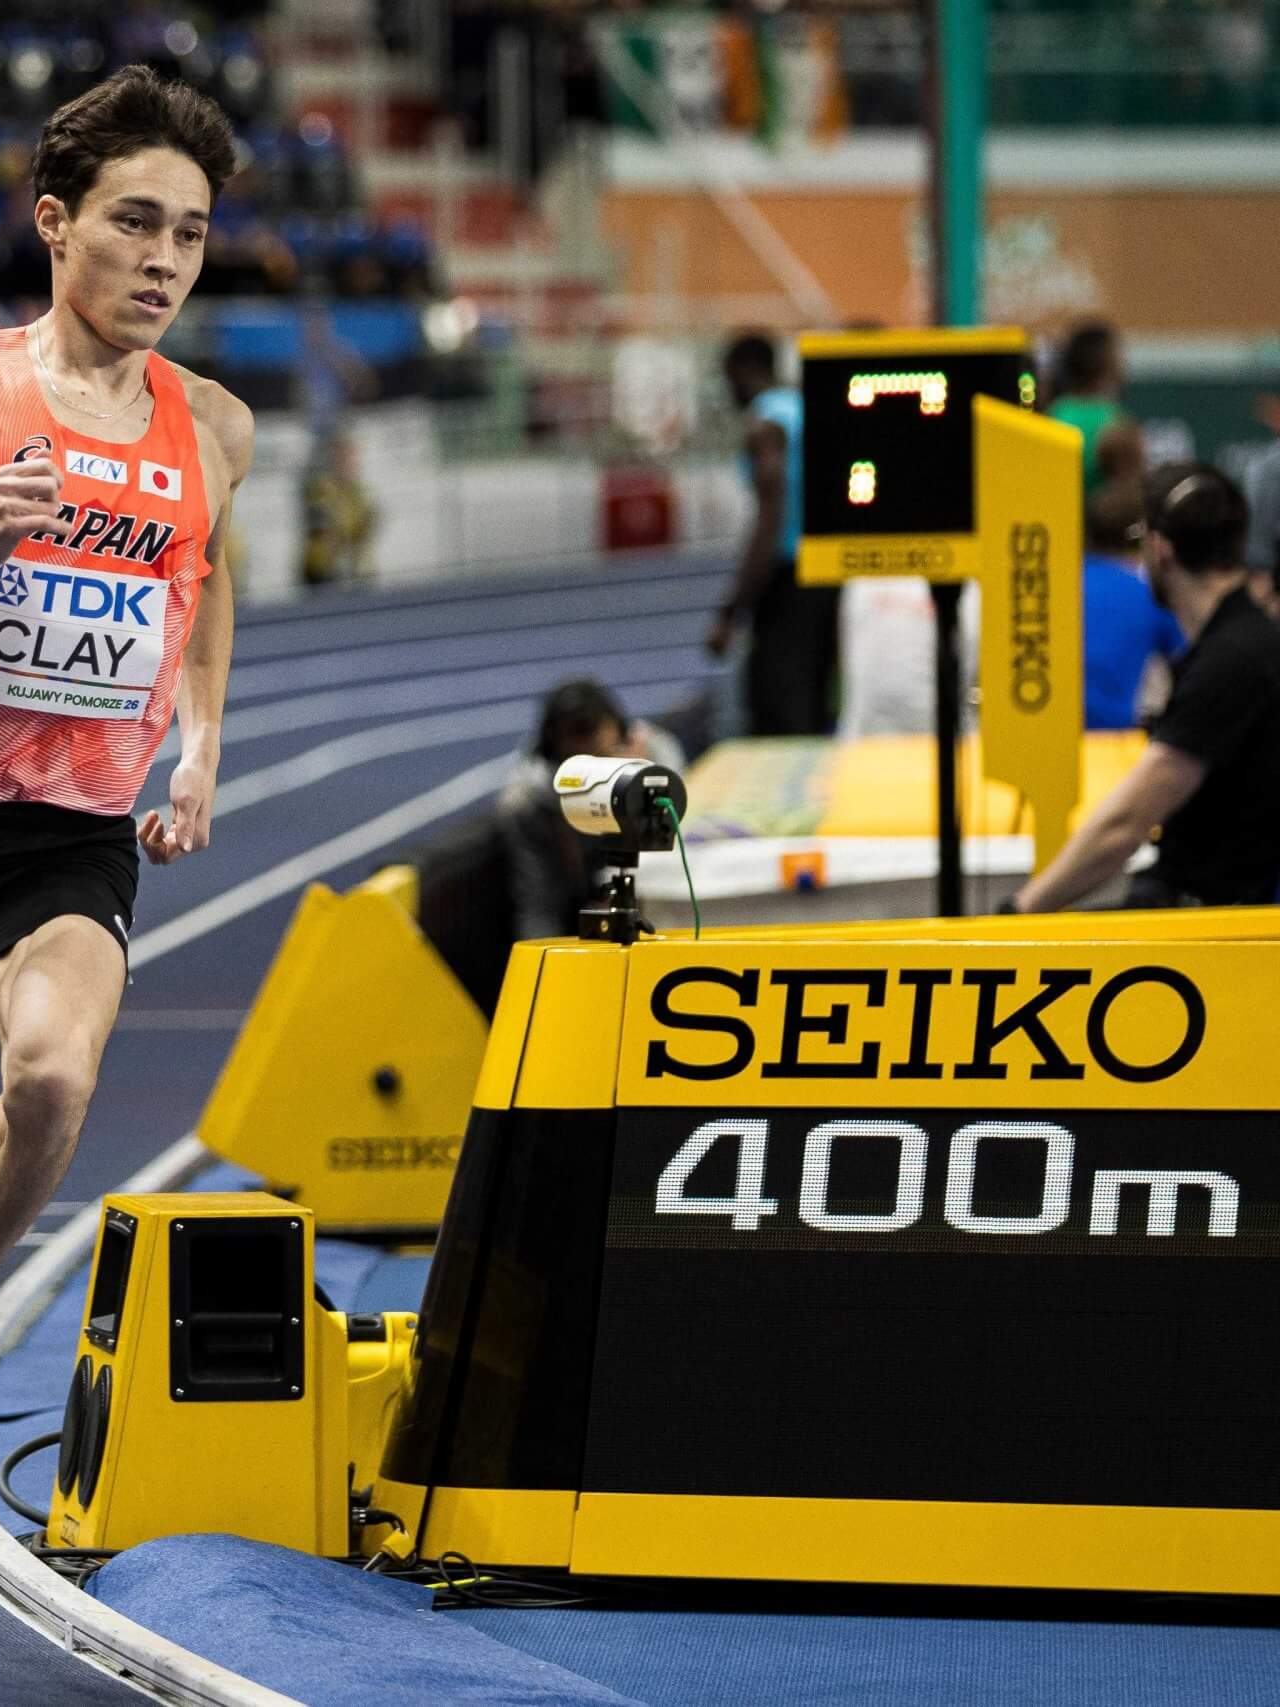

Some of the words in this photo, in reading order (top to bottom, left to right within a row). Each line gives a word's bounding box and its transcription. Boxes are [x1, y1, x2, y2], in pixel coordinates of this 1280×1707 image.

[69, 455, 124, 480] ACN
[29, 502, 176, 565] APAN
[32, 571, 155, 626] TDK
[1011, 522, 1051, 714] SEIKO
[7, 684, 62, 703] KUJAWY
[63, 693, 124, 710] POMORZE
[123, 699, 140, 710] 26
[645, 966, 1207, 1083] SEIKO
[655, 1118, 1240, 1237] 400m
